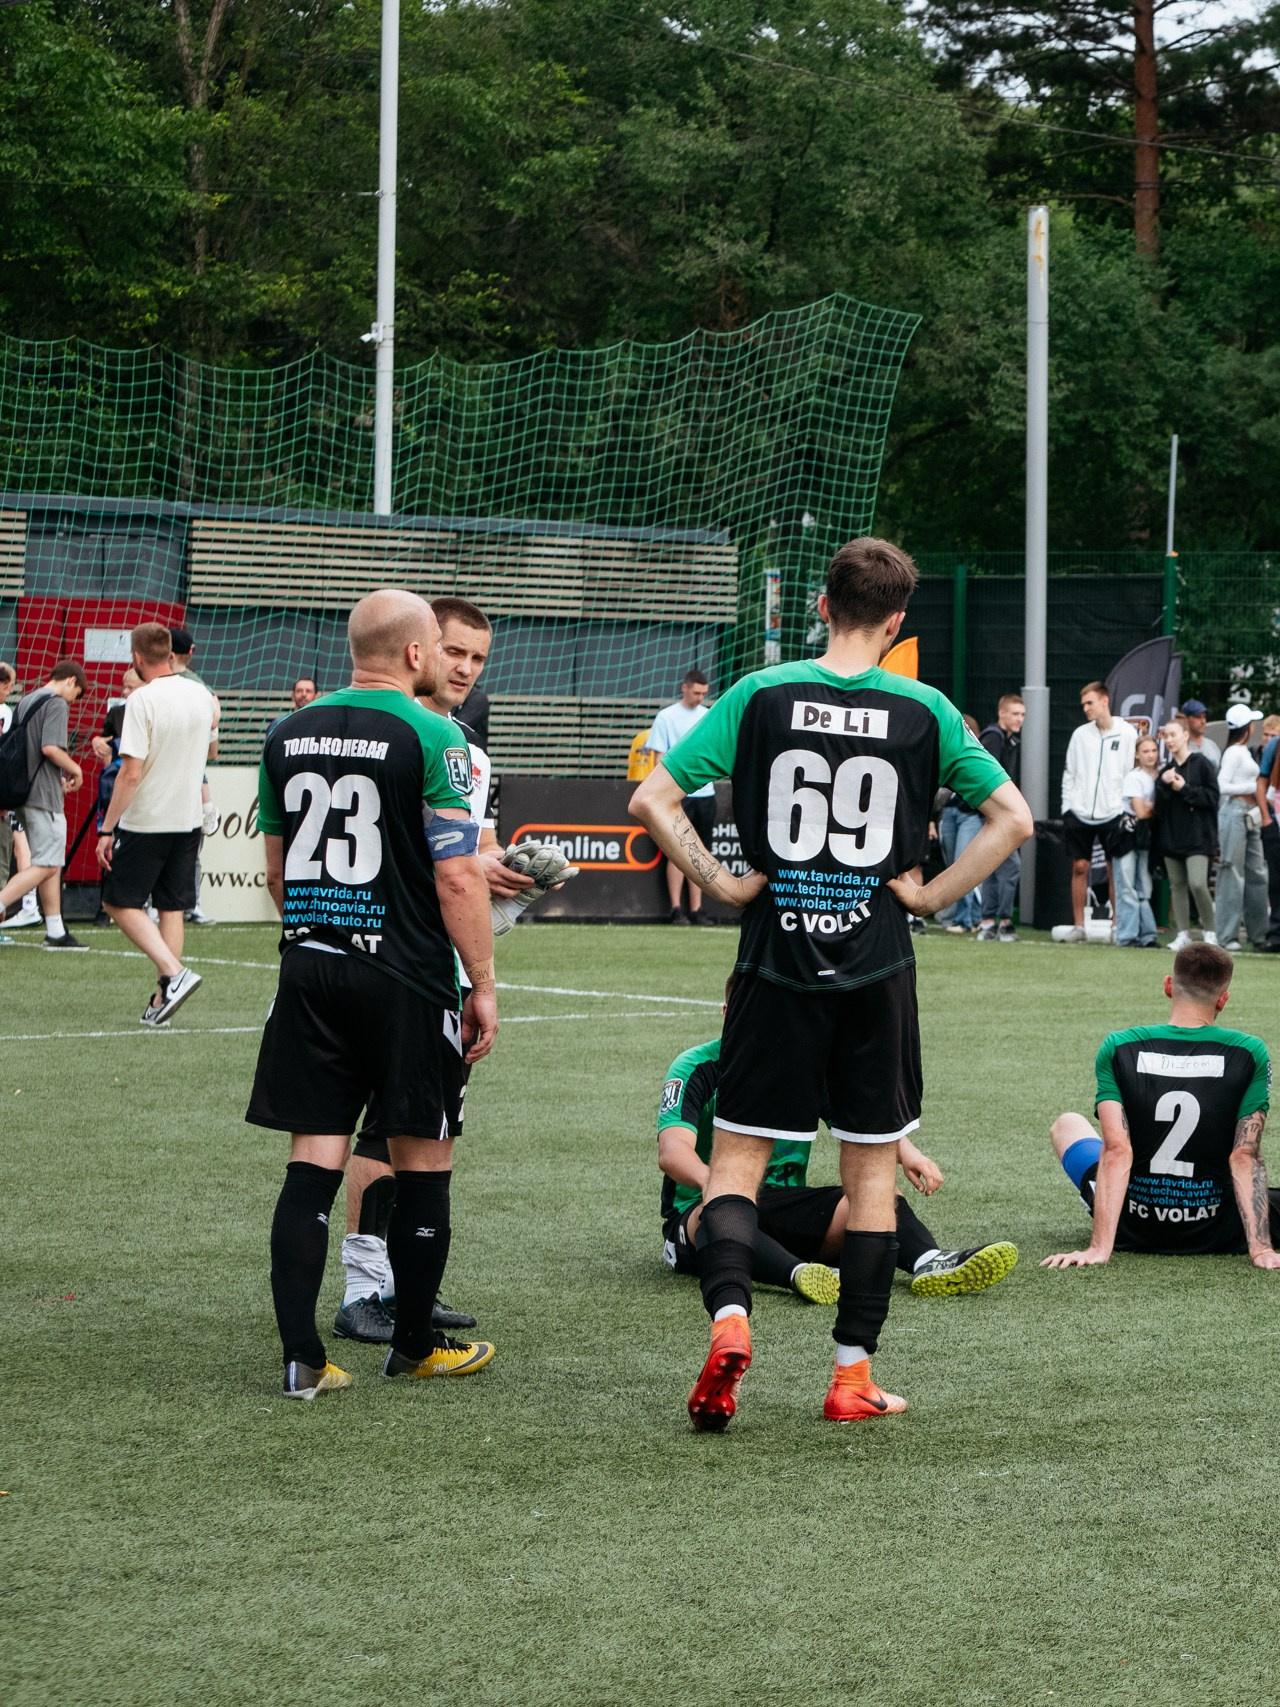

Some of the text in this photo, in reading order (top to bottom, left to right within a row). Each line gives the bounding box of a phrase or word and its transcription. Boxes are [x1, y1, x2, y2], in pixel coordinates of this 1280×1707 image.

[803, 705, 871, 735] De Li
[767, 749, 899, 868] 69
[284, 771, 383, 885] 23
[778, 868, 880, 887] www.tavrida.ru
[802, 899, 872, 935] VOLAT
[1149, 1090, 1201, 1178] 2
[1127, 1183, 1223, 1198] www.technoavia.ru
[1133, 1175, 1214, 1189] www.tavrida.ru
[1128, 1199, 1220, 1223] FC VOLAT
